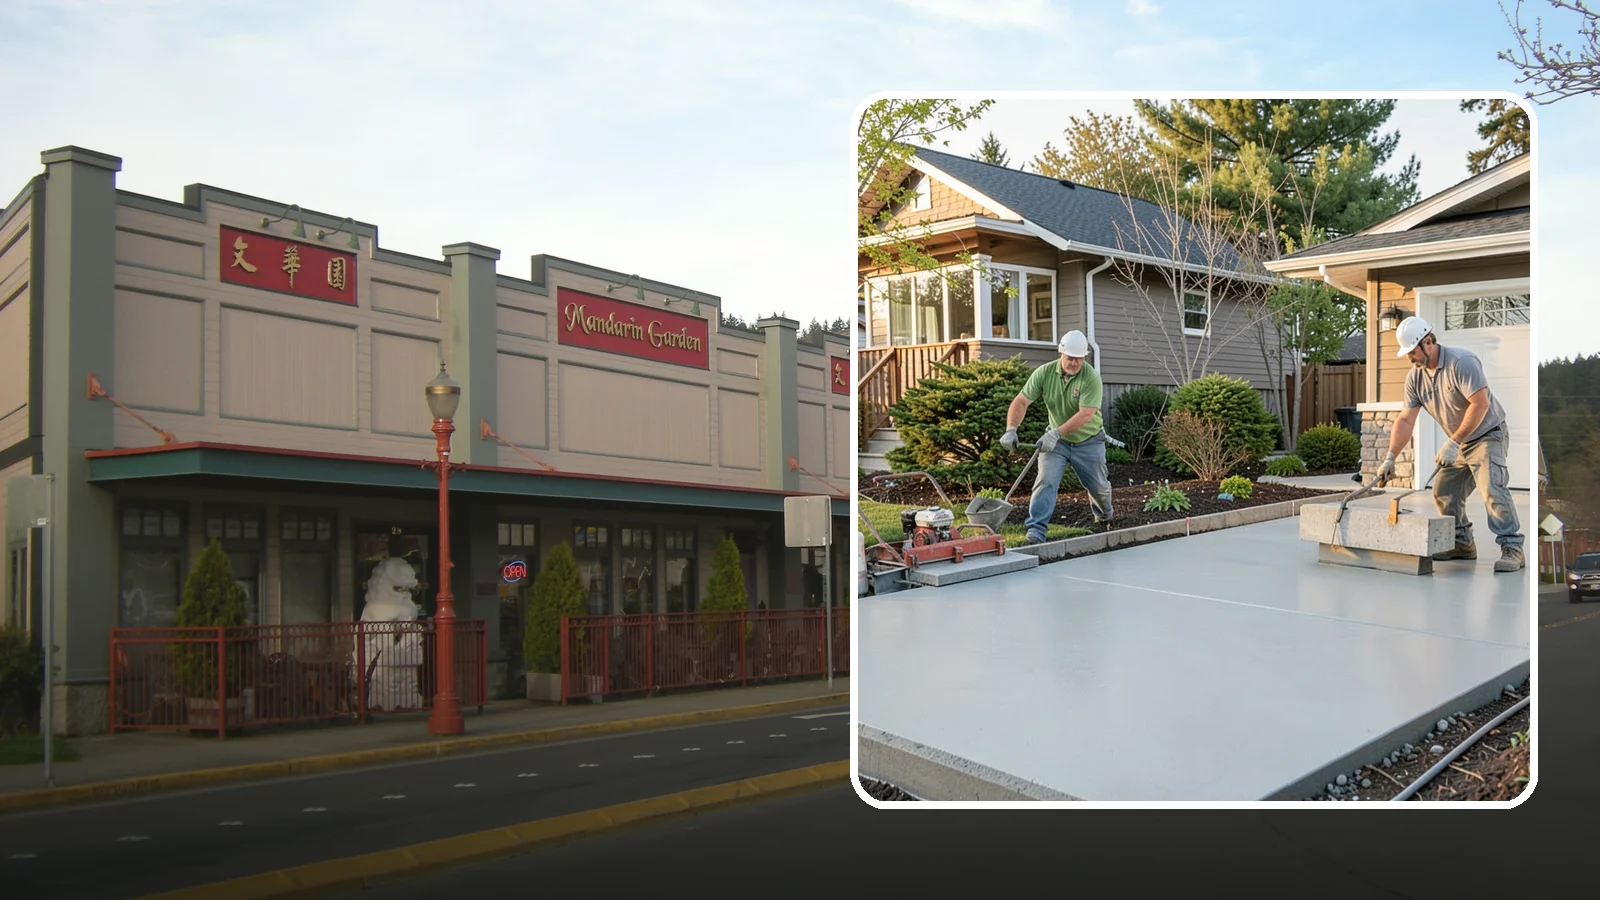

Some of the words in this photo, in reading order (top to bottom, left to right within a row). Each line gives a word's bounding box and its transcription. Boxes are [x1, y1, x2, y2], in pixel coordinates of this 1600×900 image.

[231, 236, 346, 290] 文華園
[564, 302, 644, 340] Mandarin
[648, 320, 701, 352] Garden
[503, 565, 527, 578] OPEN
